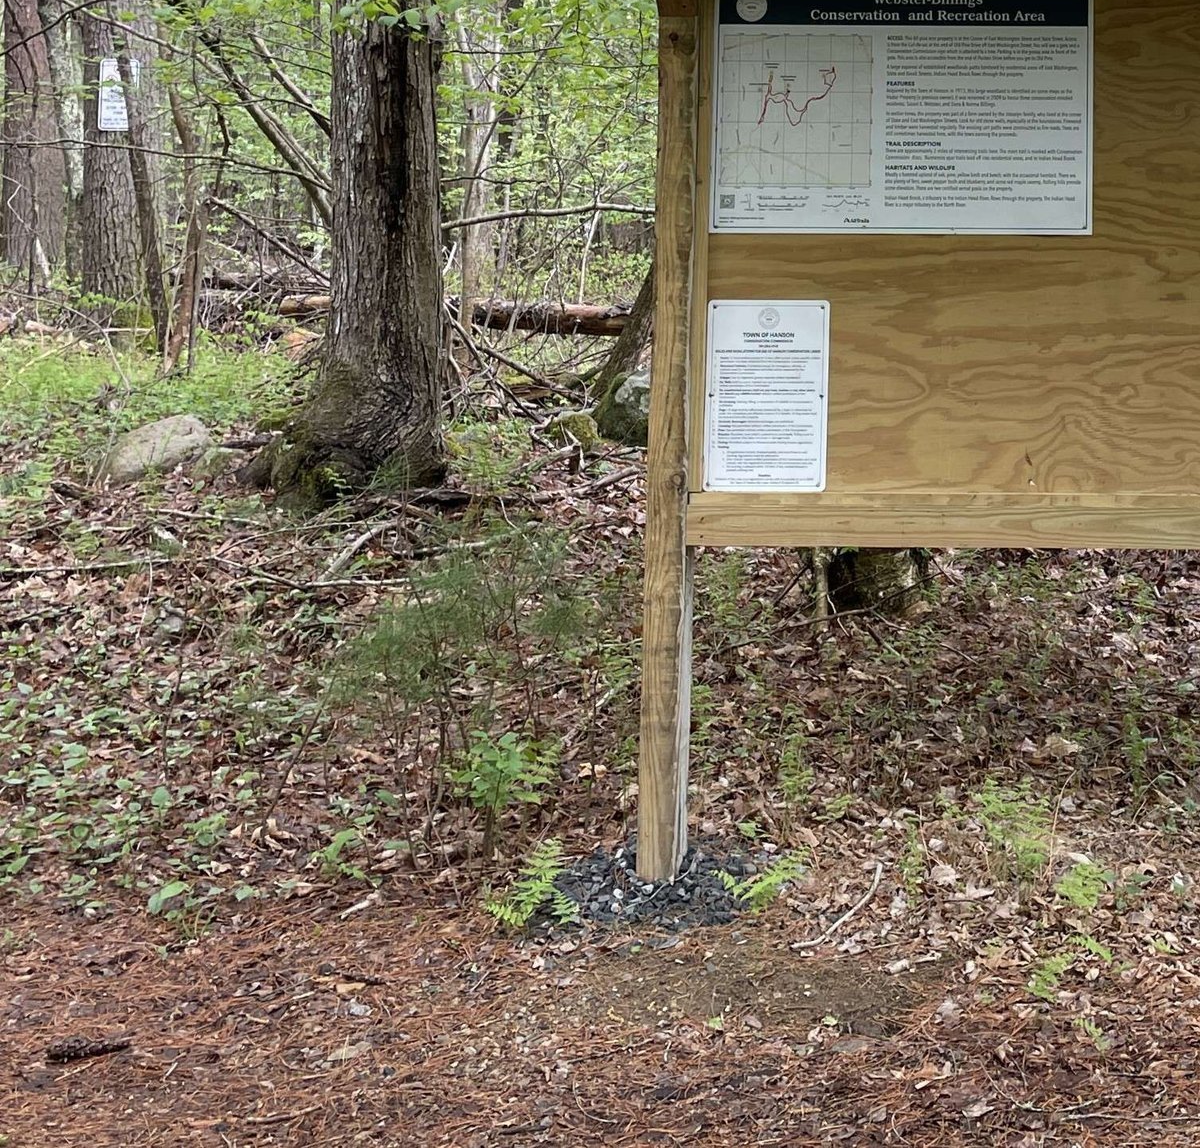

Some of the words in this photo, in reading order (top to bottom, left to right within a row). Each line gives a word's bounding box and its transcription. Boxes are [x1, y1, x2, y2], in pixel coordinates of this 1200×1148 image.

[810, 9, 900, 22] Conservation
[908, 9, 934, 21] and
[937, 9, 1010, 21] Recreation
[1014, 9, 1045, 21] Area
